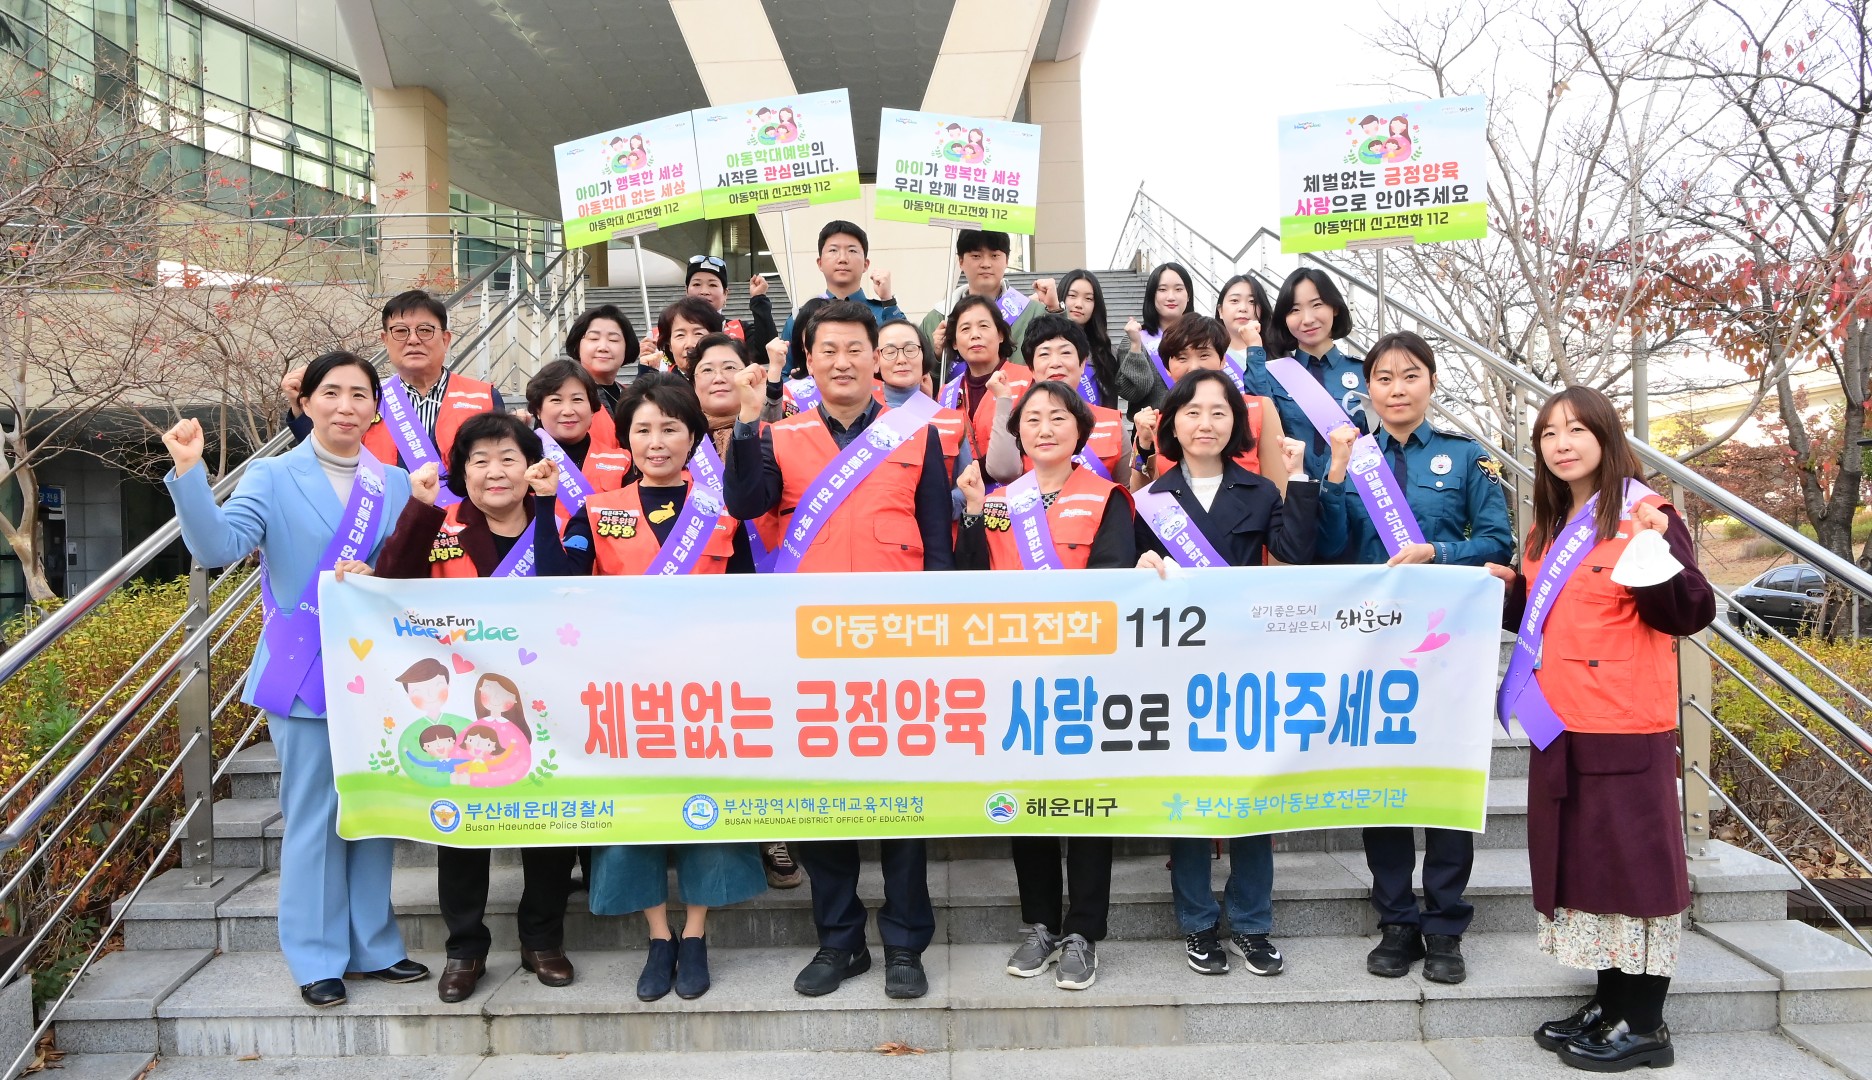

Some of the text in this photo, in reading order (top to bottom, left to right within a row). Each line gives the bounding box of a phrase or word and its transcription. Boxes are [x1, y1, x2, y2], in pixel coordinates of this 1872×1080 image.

[726, 141, 825, 169] 아동학대예방의
[576, 162, 684, 201] 아이가 행복한 세상
[717, 157, 840, 188] 시작은 관심입니다.
[896, 159, 1021, 187] 아이가 행복한 세상
[1303, 161, 1459, 193] 체벌없는 긍정양육
[578, 180, 686, 218] 아동학대 없는 세상
[729, 181, 831, 205] 아동학대 신고전화 112
[894, 177, 1019, 204] 우리 함께 만들어요
[1295, 184, 1469, 217] 사랑으로 안아주세요
[589, 202, 679, 233] 아동학대 신고전화 112
[903, 199, 1008, 220] 아동학대 신고전화 112
[1314, 211, 1449, 235] 아동학대 신고전화 112
[794, 447, 874, 542] 아동학대 없는 세상
[1364, 469, 1394, 509] 아동학대
[348, 496, 374, 545] 아동학대
[433, 536, 460, 549] 동위원
[673, 515, 705, 563] 아동학대
[1022, 516, 1046, 563] 체벌없는
[1526, 525, 1594, 636] 체벌없는 긍정양육
[393, 616, 520, 646] Haeundae
[408, 614, 475, 627] Sun&Fun
[811, 605, 1208, 649] 아동학대 신고전화 112
[1335, 608, 1403, 634] 해운대
[580, 669, 1420, 760] 체벌없는 긍정양육 사랑으로 안아주세요
[465, 799, 615, 821] 부산해운대경찰서
[723, 796, 924, 816] 부산광역시해운대교육지원청
[1025, 797, 1118, 818] 해운대구
[1195, 787, 1408, 819] 부산동부아동보호전문기관
[465, 820, 613, 832] Busan Haeundae Police Station
[725, 818, 752, 826] BUSAN
[753, 817, 797, 825] HAEUNDAE
[798, 816, 834, 824] DISTRICT
[835, 816, 864, 824] OFFICE
[879, 815, 925, 823] EDUCATION
